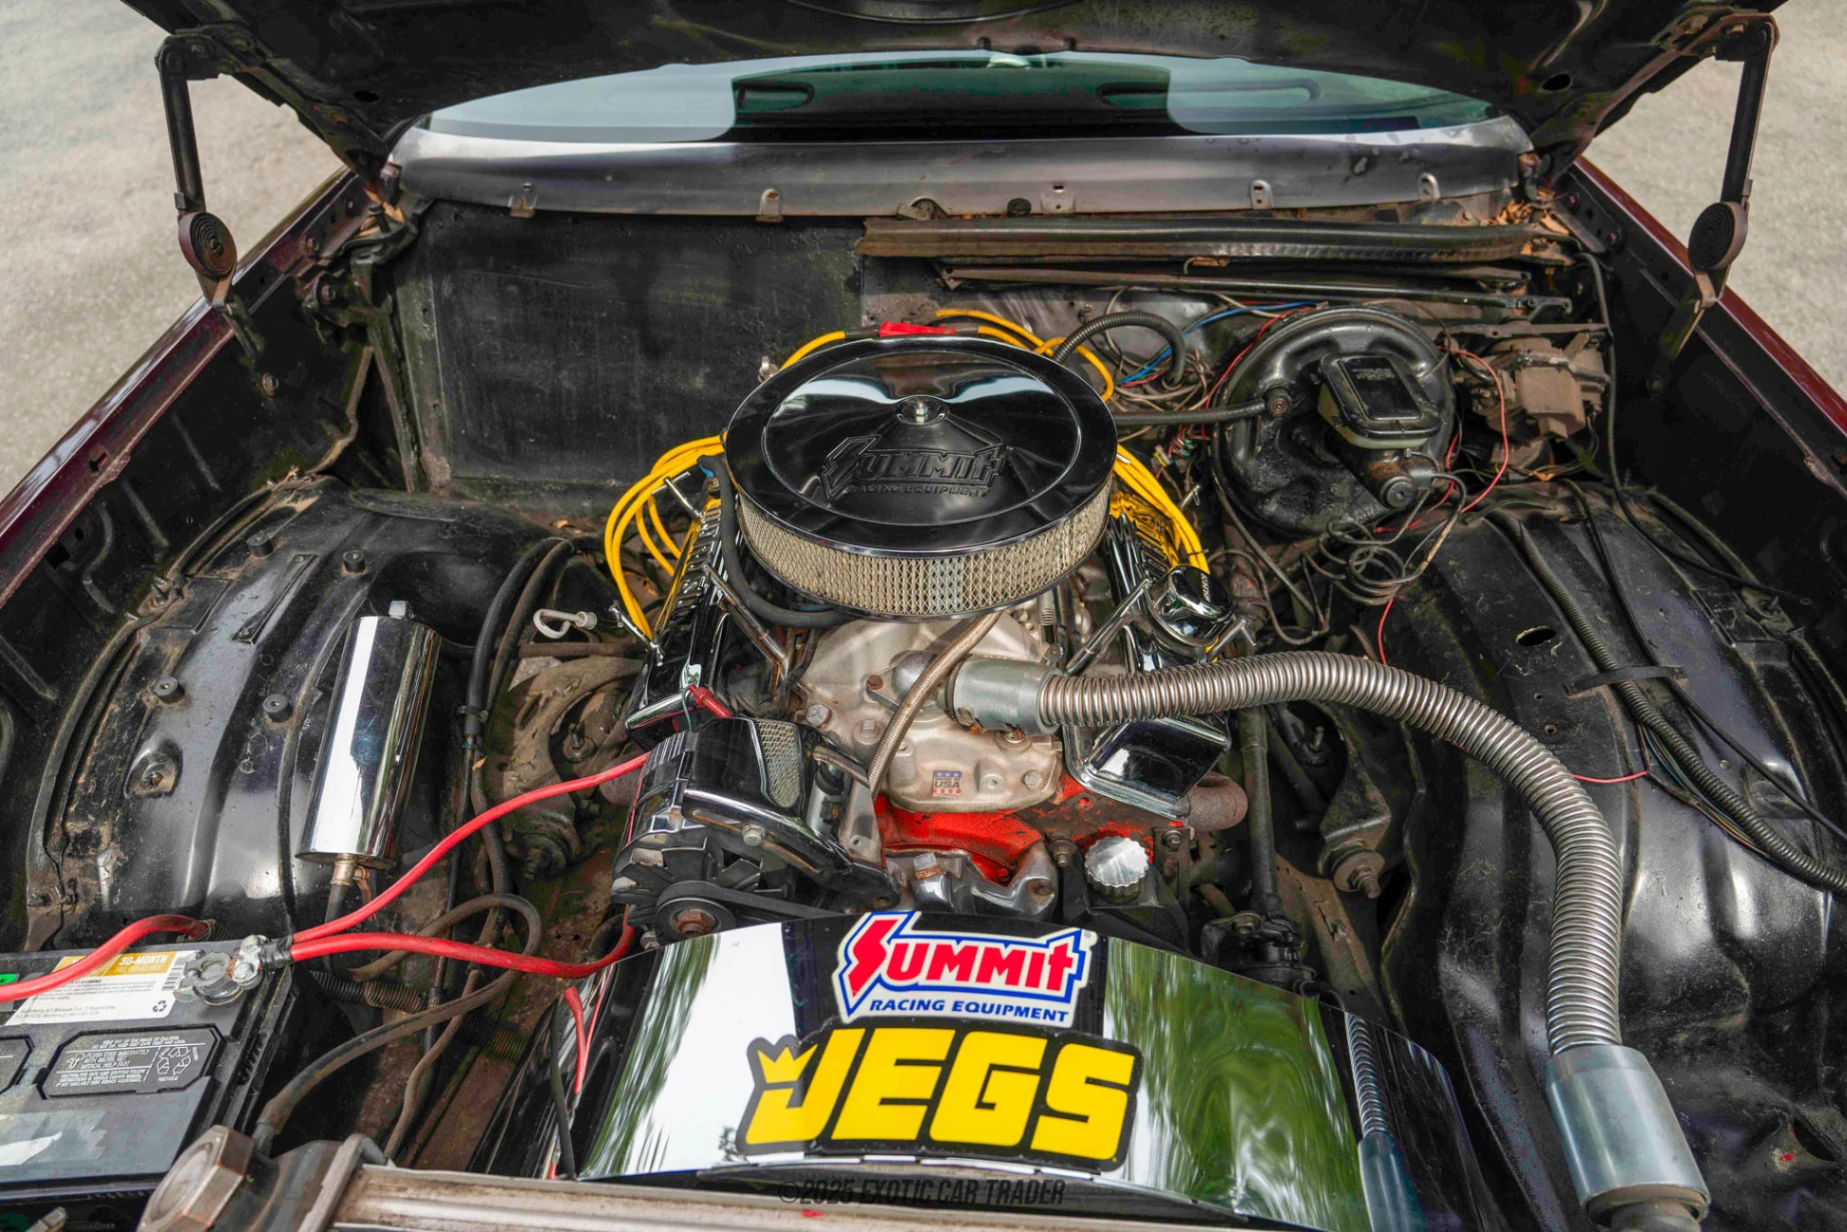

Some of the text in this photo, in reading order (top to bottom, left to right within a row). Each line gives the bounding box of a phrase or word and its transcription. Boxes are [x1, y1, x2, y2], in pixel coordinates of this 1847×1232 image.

[904, 485, 989, 497] EQUIPMENT
[119, 954, 168, 966] 30-MONTH
[869, 999, 1068, 1022] RACING EQUIPMENT
[745, 1027, 1135, 1161] JEGS
